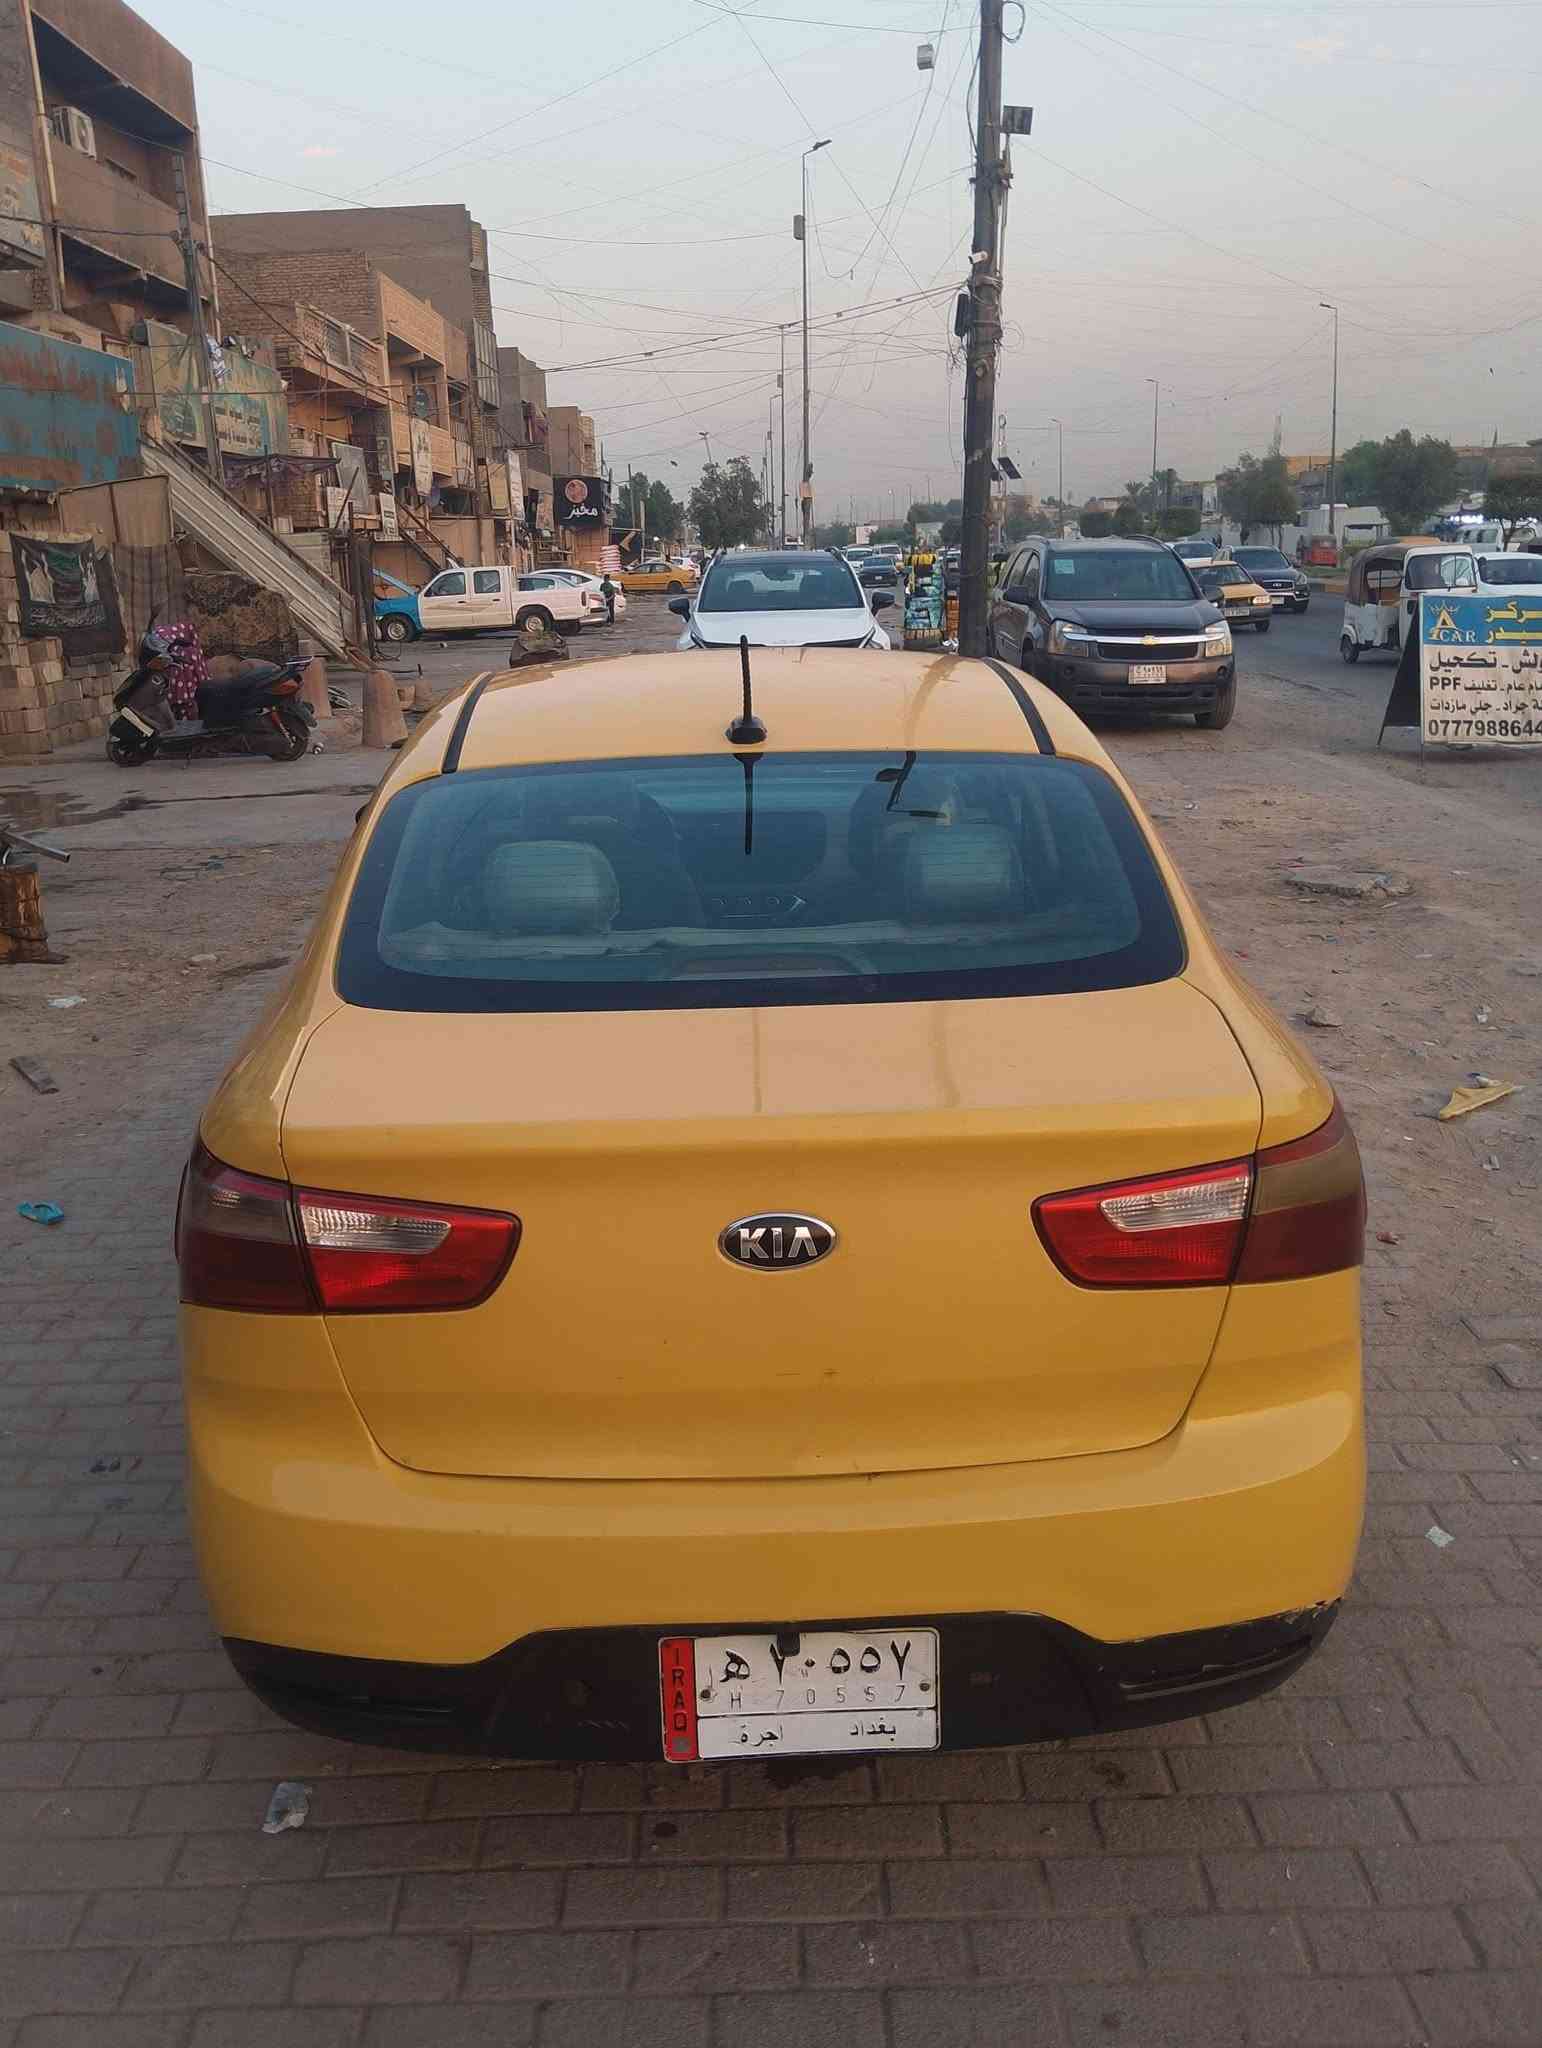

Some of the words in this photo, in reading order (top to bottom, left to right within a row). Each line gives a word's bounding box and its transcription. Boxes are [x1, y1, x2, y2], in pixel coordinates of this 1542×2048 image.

[1486, 601, 1542, 623] ركز
[1440, 629, 1477, 642] CAR
[1430, 677, 1461, 690] PPF
[738, 1226, 818, 1259] KIA
[672, 1648, 688, 1732] IRAQ
[730, 1691, 742, 1710] H
[850, 1716, 896, 1742] بغداد
